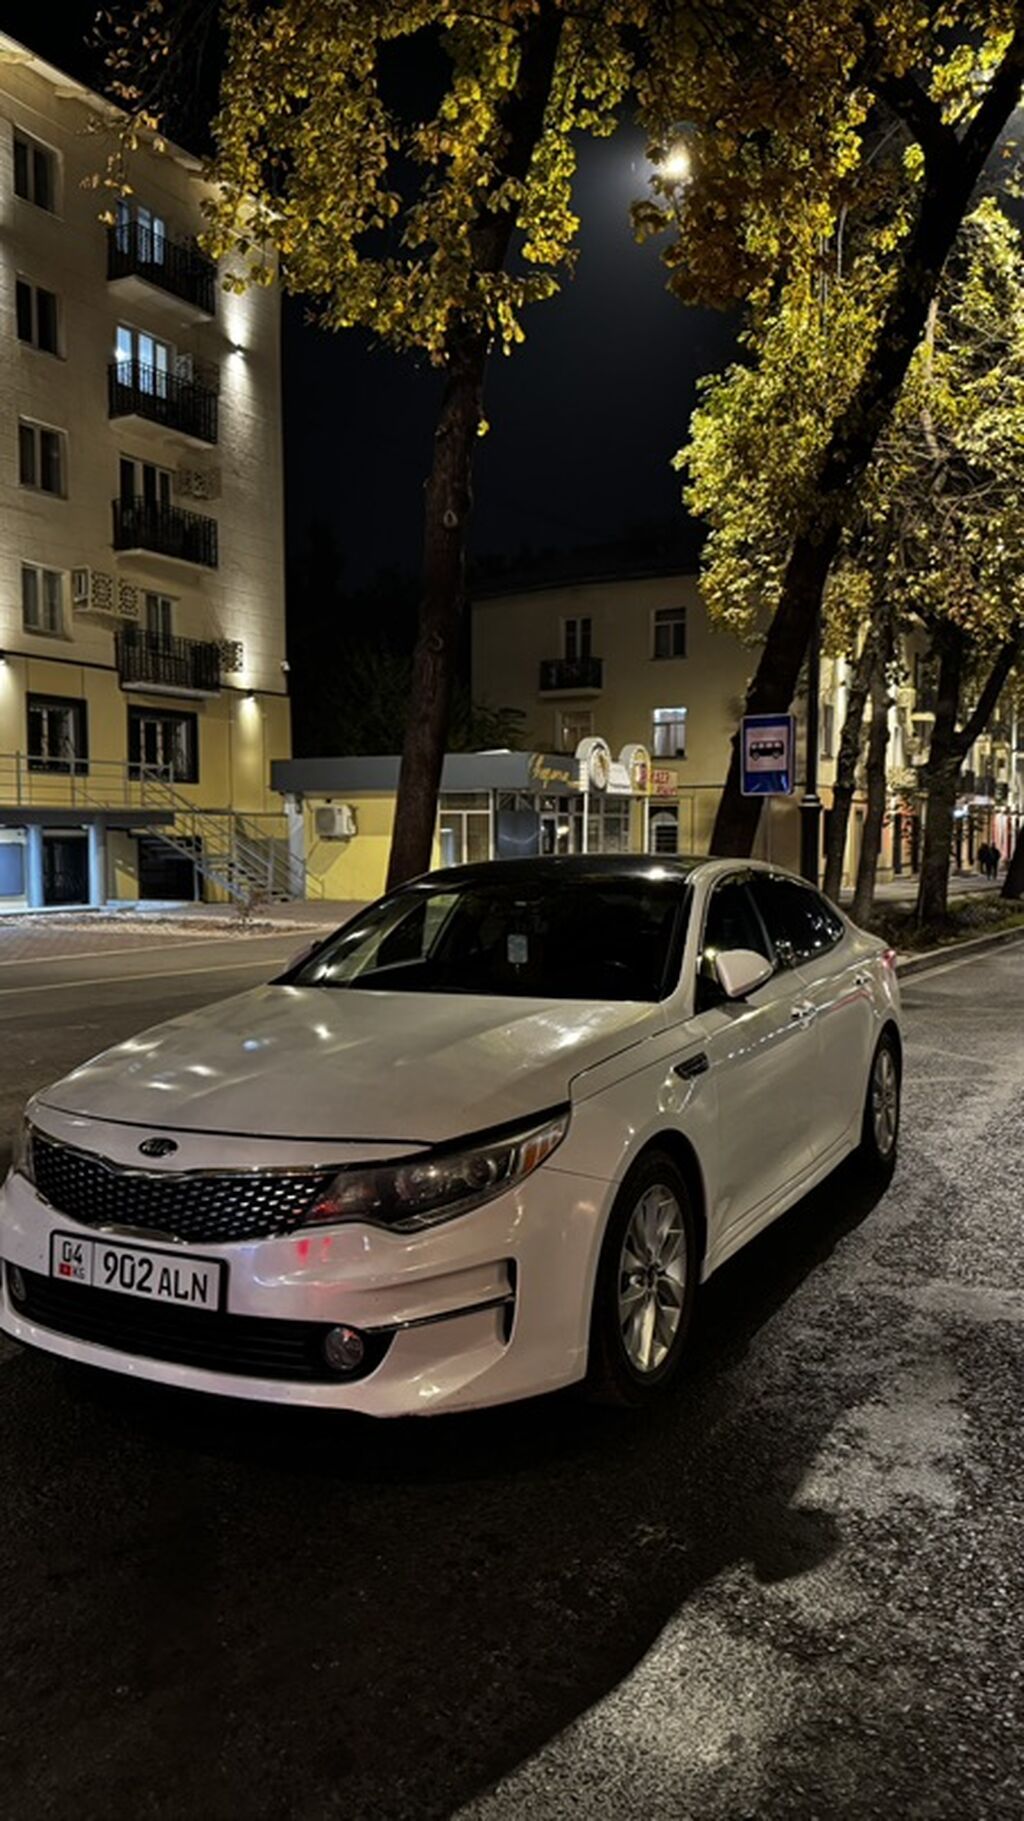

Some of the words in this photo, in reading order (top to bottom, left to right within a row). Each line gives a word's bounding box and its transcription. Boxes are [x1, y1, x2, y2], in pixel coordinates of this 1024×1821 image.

[62, 1241, 82, 1264] 04
[103, 1251, 153, 1293] 902
[158, 1267, 207, 1303] ALN
